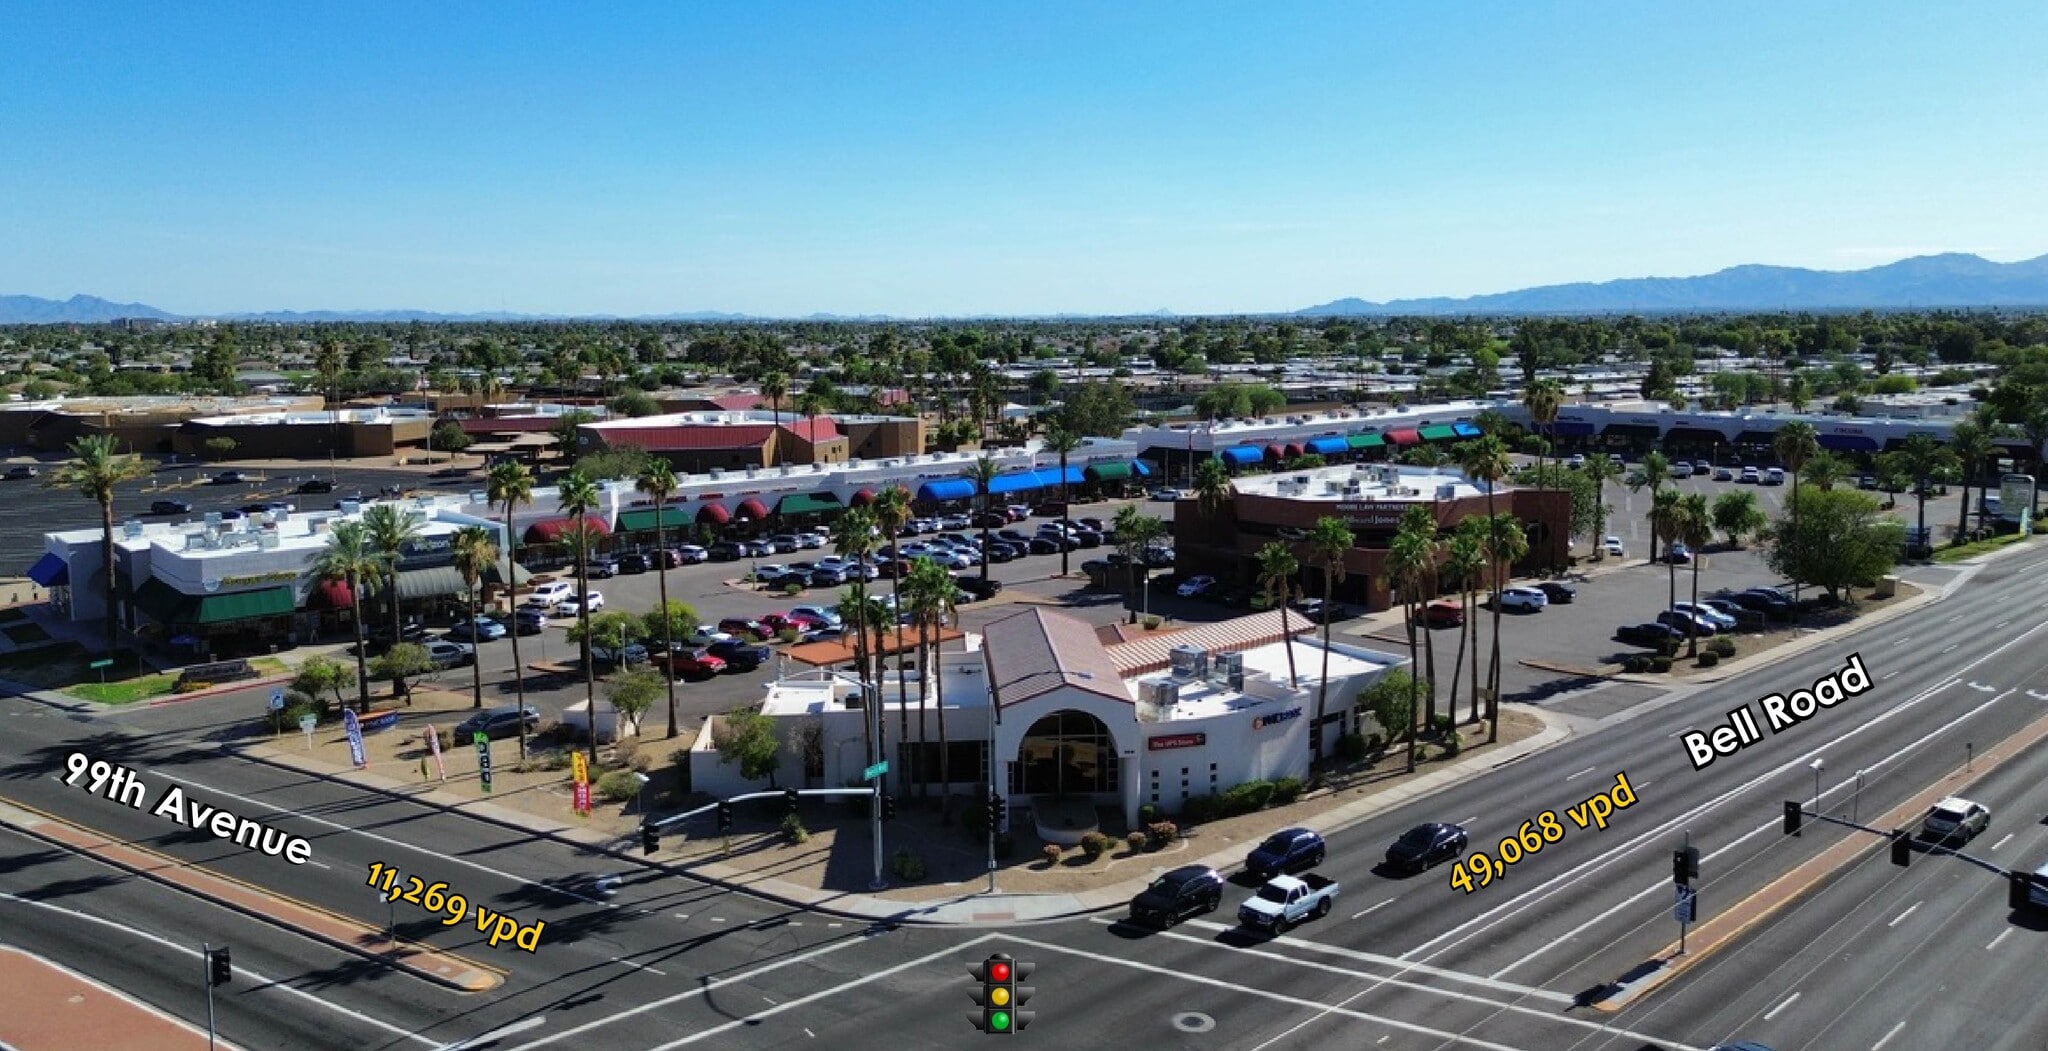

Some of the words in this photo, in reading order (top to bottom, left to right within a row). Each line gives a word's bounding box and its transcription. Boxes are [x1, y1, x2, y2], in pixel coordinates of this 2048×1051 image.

[1359, 503, 1374, 512] LAW
[1374, 514, 1400, 525] Jones
[1153, 741, 1164, 749] The
[1164, 739, 1178, 748] UPS
[1178, 738, 1194, 746] Store
